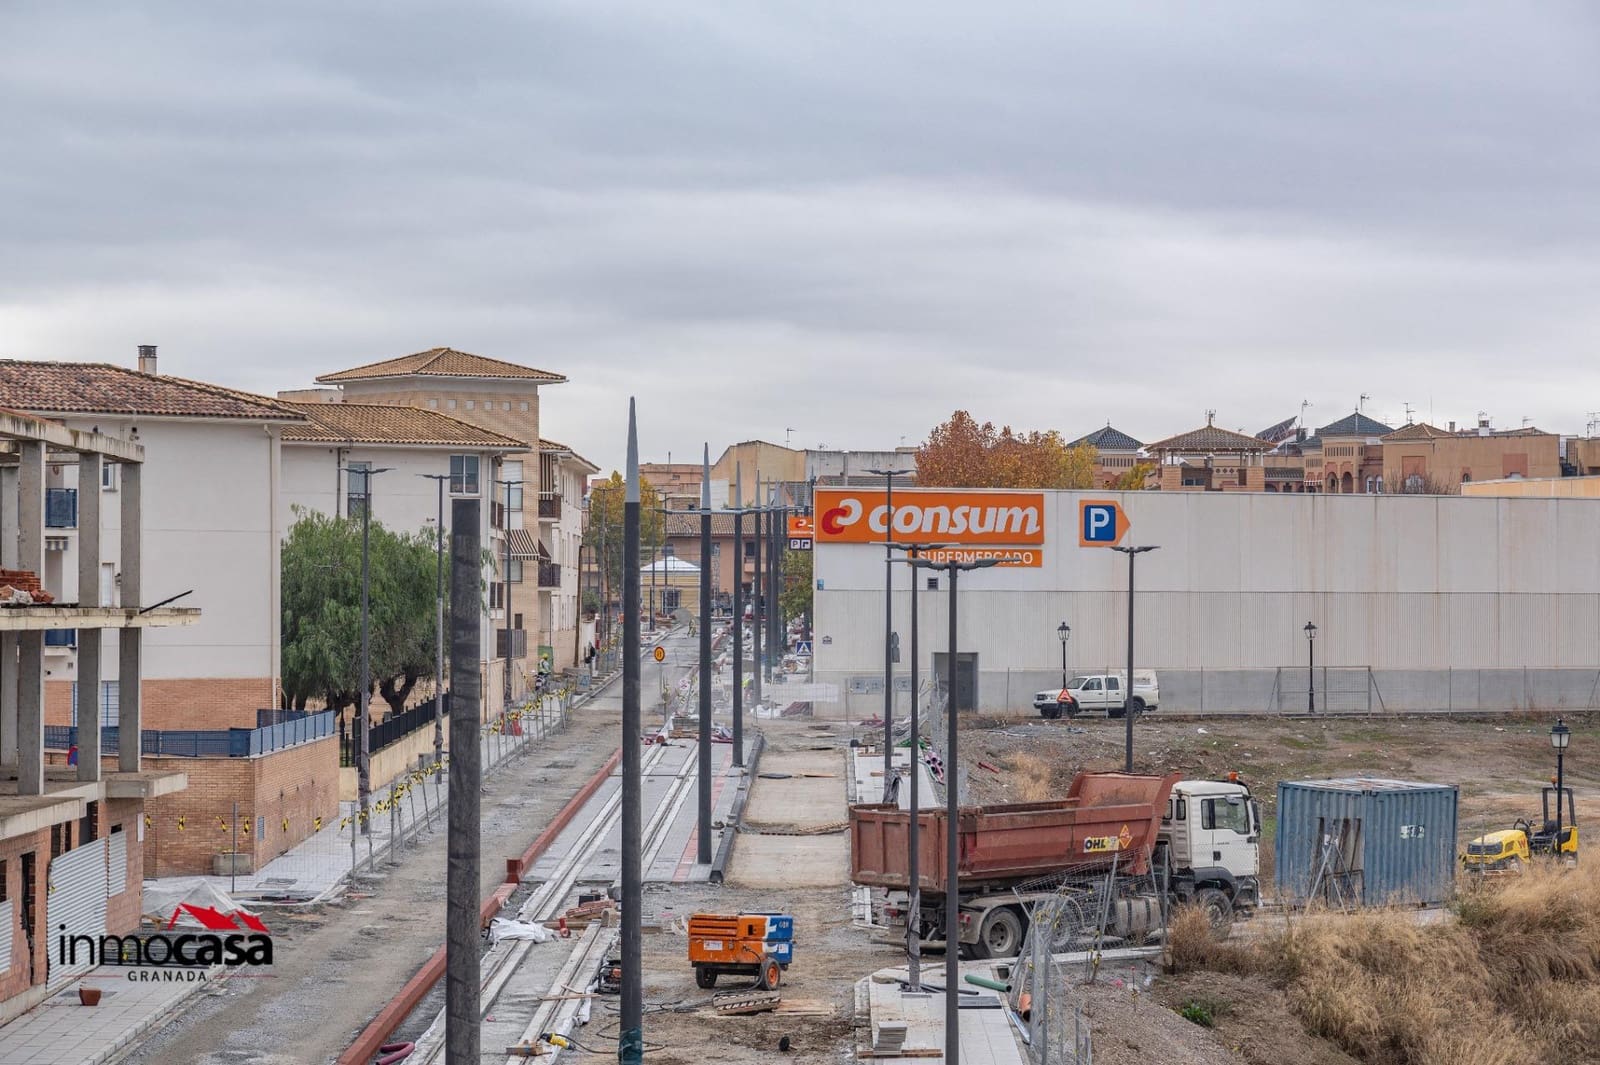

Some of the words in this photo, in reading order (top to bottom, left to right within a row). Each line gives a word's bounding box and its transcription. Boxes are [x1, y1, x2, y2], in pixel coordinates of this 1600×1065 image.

[868, 504, 1040, 535] consum
[1090, 507, 1110, 539] P
[1085, 838, 1106, 850] OHL
